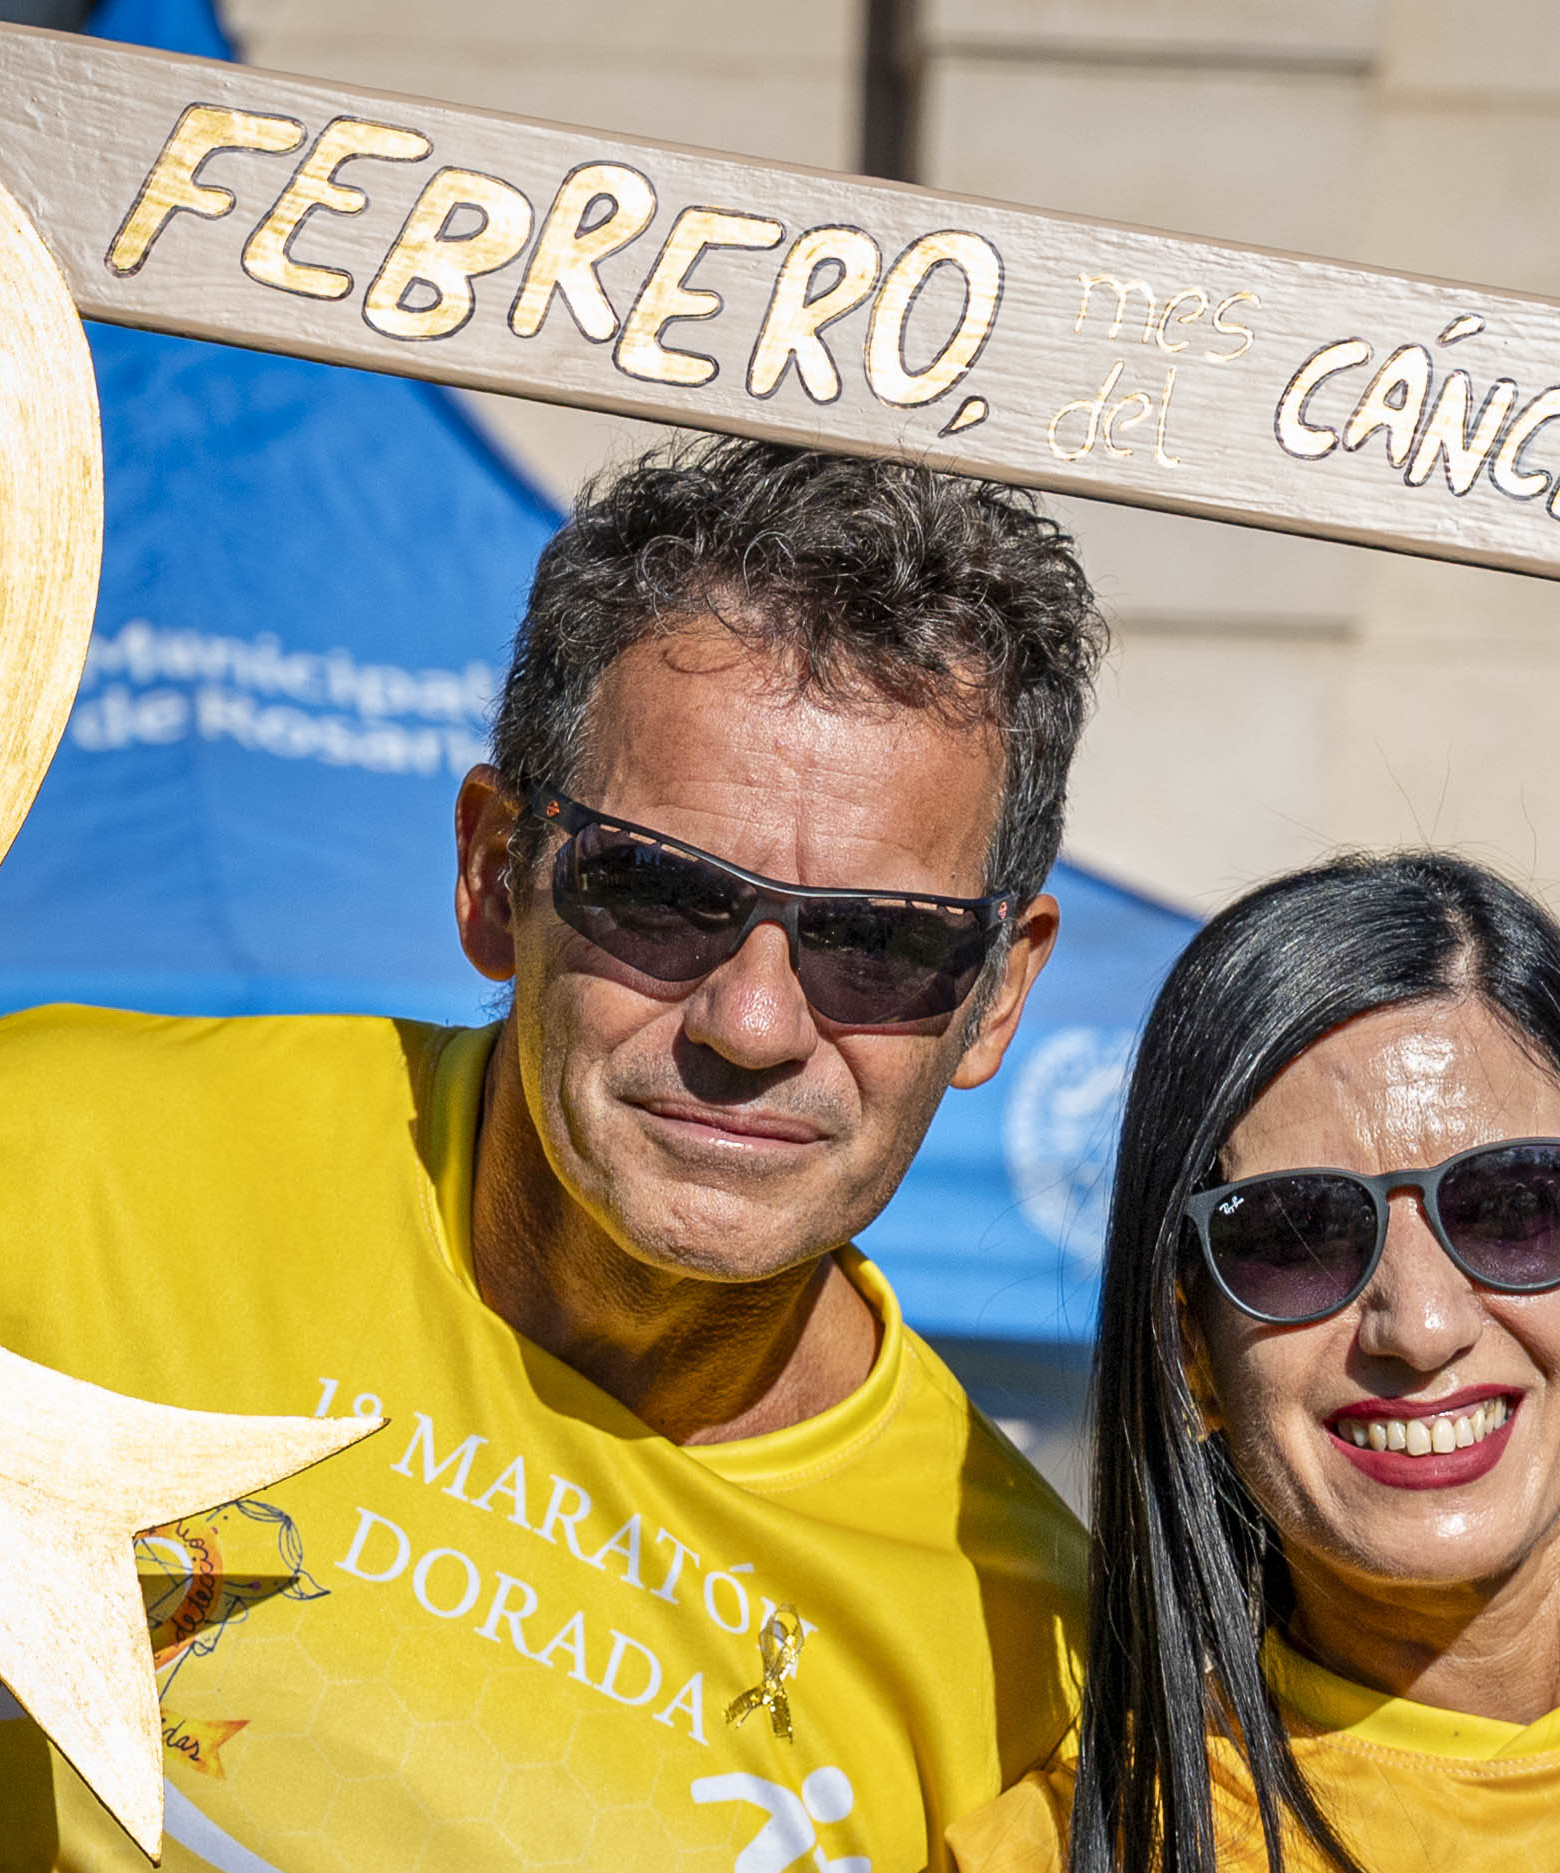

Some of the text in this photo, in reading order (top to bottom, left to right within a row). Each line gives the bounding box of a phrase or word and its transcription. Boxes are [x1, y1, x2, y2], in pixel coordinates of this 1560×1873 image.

[106, 101, 1006, 439] FEBRERO,
[1074, 272, 1262, 362] mes
[1047, 359, 1181, 468] del
[335, 1507, 712, 1748] DORADA
